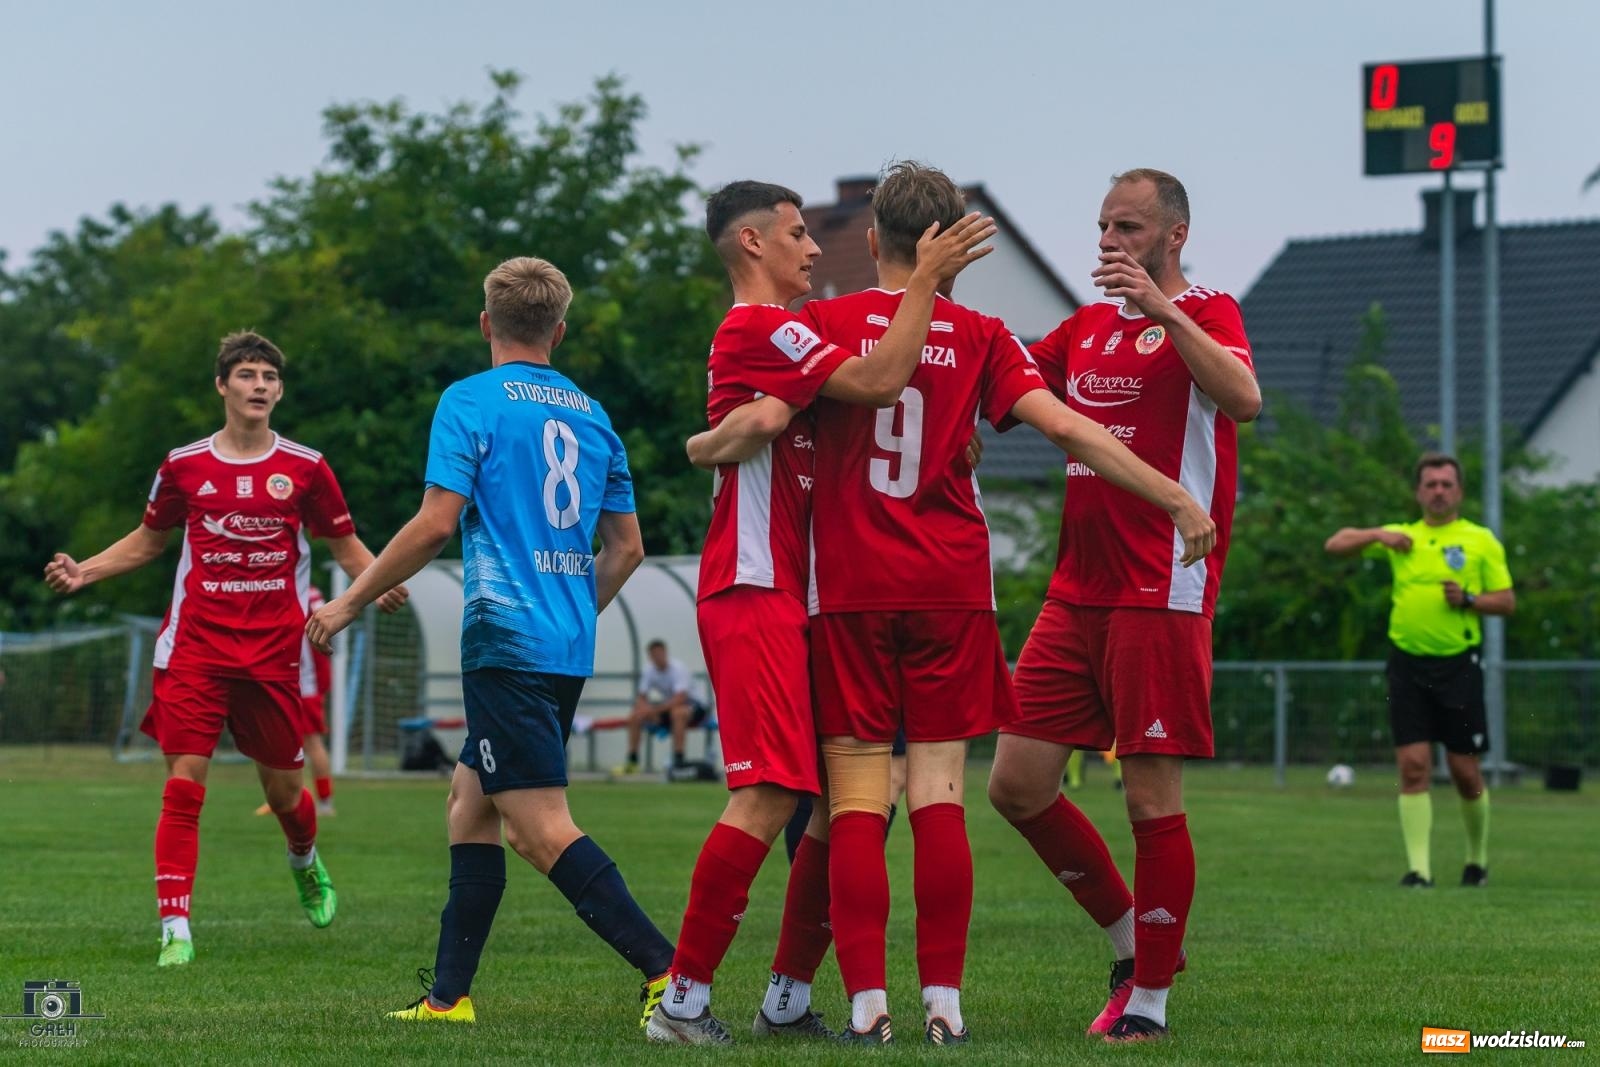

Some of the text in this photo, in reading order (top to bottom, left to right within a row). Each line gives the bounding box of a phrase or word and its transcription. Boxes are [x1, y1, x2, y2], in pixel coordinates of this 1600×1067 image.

[1370, 64, 1399, 111] 0
[1429, 121, 1456, 169] 9
[785, 327, 800, 345] 3
[503, 381, 593, 415] STUDZIENNA
[869, 386, 924, 498] 9
[543, 418, 581, 530] 8
[221, 579, 286, 593] WENINGER
[479, 738, 496, 774] 8
